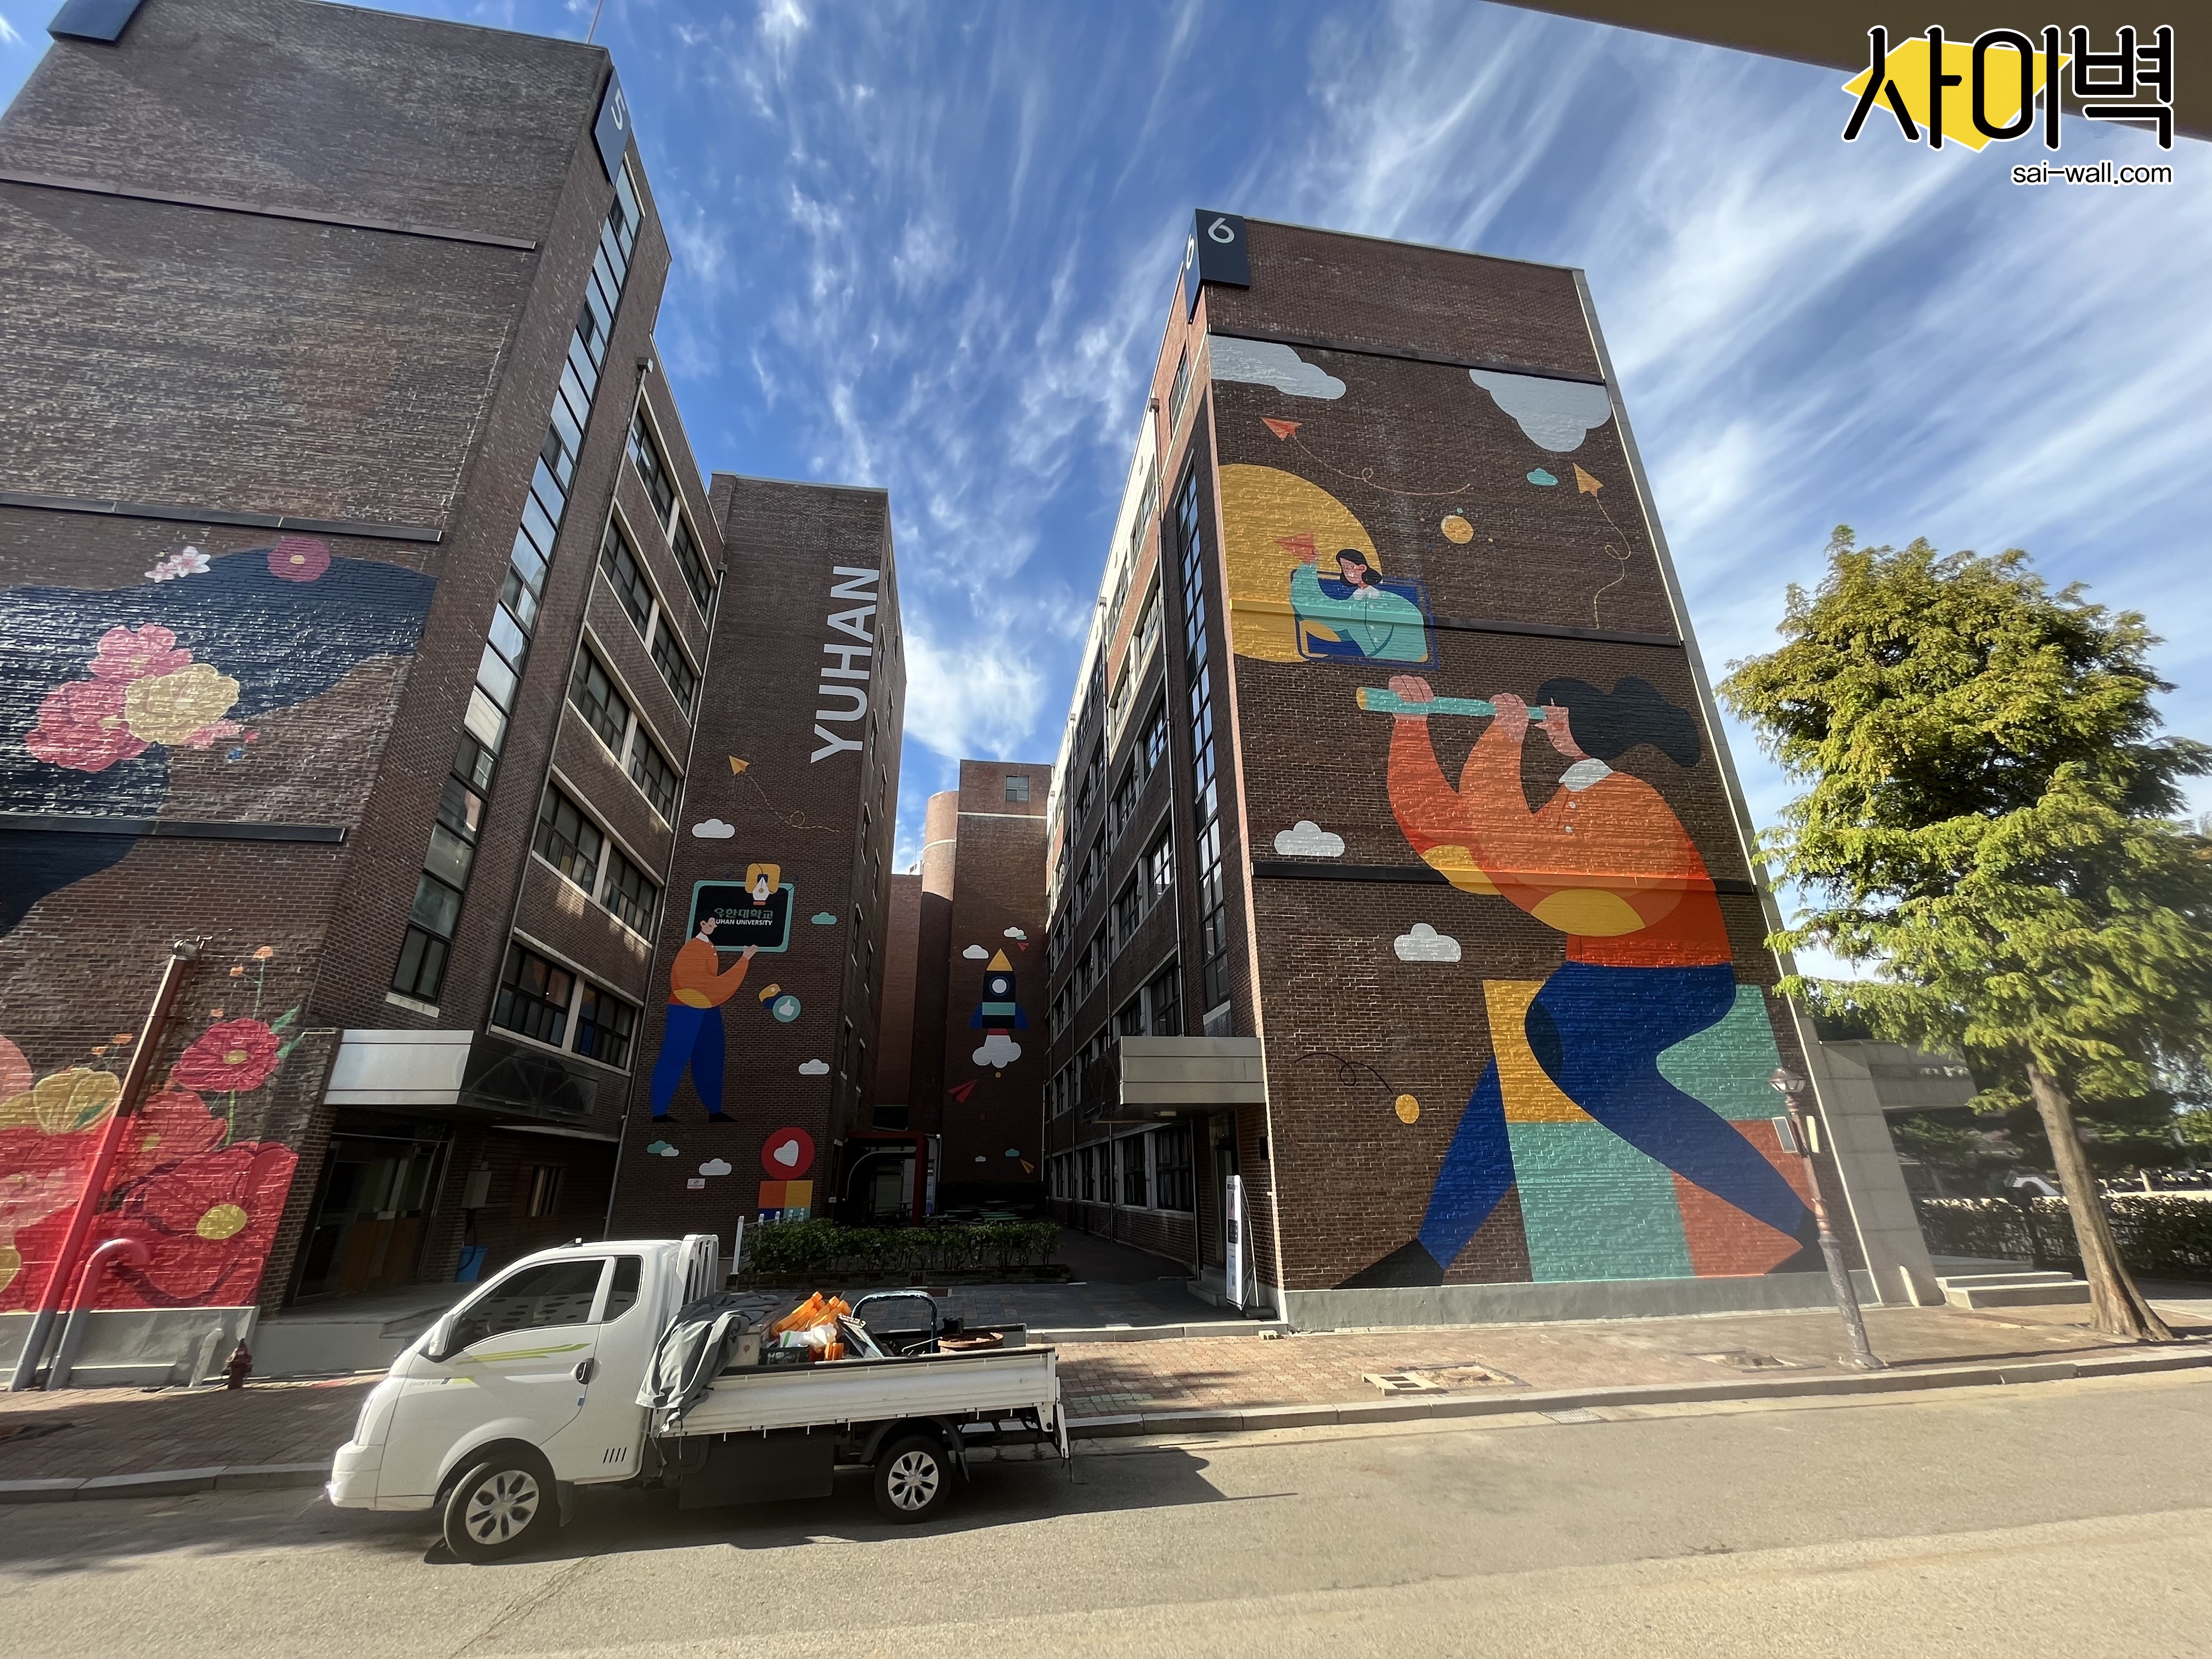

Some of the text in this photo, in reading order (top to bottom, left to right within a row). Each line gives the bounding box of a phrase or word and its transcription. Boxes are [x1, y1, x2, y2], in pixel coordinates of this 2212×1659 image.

[611, 87, 625, 131] 5
[1207, 217, 1235, 244] 6
[810, 566, 880, 764] YUHAN
